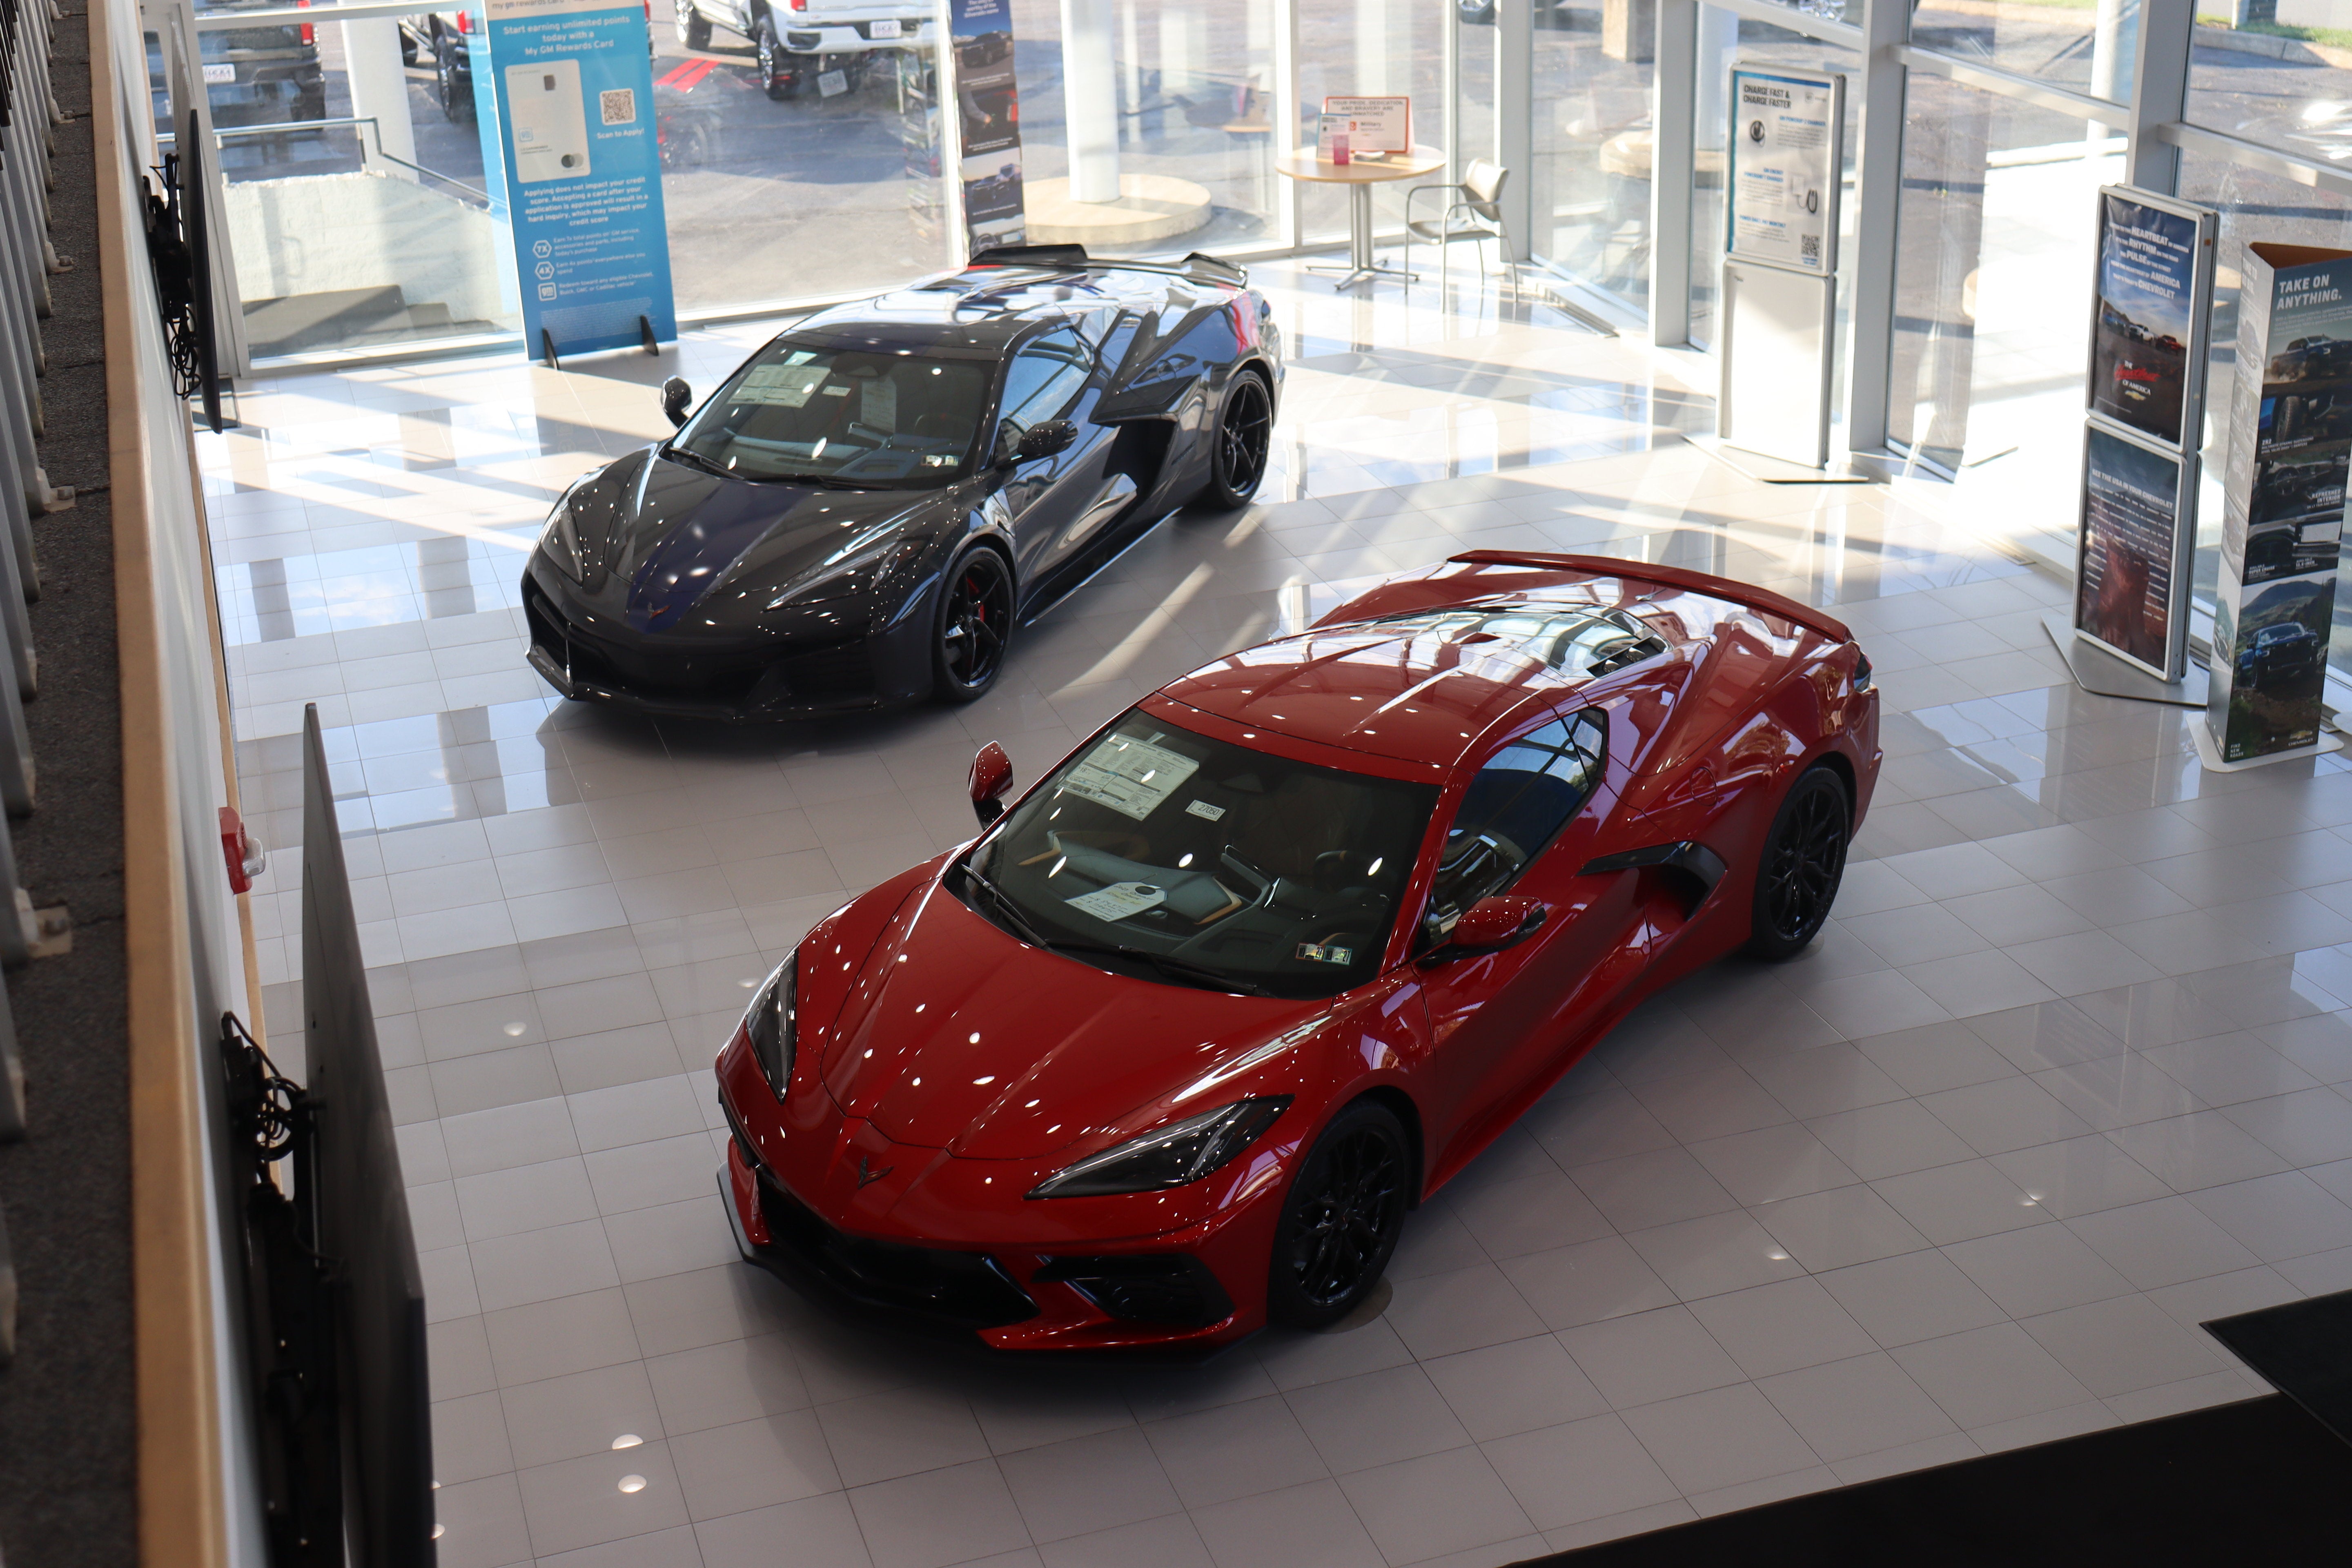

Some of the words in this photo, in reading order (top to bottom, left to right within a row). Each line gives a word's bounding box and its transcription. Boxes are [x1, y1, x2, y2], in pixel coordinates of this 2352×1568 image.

[503, 24, 525, 35] Start
[528, 22, 561, 34] earning
[562, 17, 601, 29] unlimited
[604, 15, 630, 26] points
[542, 33, 566, 43] today
[569, 30, 587, 39] with
[525, 47, 538, 56] My
[540, 45, 554, 53] GM
[556, 41, 592, 52] Rewards
[593, 38, 614, 48] Card
[1744, 84, 1768, 96] CHARGE
[1770, 88, 1783, 98] FAST
[1785, 90, 1789, 98] &
[1744, 94, 1768, 105] CHARGE
[1769, 98, 1791, 109] FASTER
[597, 131, 614, 139] Scan
[623, 127, 644, 137] Apply!
[523, 187, 554, 198] Applying
[586, 181, 608, 190] impact
[551, 192, 586, 203] Accepting
[525, 204, 562, 215] application
[571, 199, 601, 209] approved
[545, 212, 570, 221] inquiry,
[571, 209, 591, 217] which
[608, 204, 630, 213] impact
[2132, 226, 2169, 246] HEARTBEAT
[2129, 238, 2156, 255] RHYTHM
[2126, 249, 2147, 264] PULSE
[2151, 271, 2180, 289] AMERICA
[2278, 276, 2310, 294] TAKE
[2313, 273, 2329, 288] ON
[2138, 279, 2174, 299] CHEVROLET
[2276, 287, 2342, 312] ANYTHING.
[2124, 360, 2132, 370] THE
[2123, 379, 2129, 387] OF
[2129, 381, 2151, 395] AMERICA
[2092, 468, 2100, 478] SEE
[2102, 472, 2111, 482] THE
[2112, 477, 2123, 487] USA
[2123, 481, 2128, 490] IN
[2129, 484, 2142, 496] YOUR
[2142, 490, 2173, 510] CHEVROLET
[2312, 489, 2341, 499] REFRESHED
[2317, 494, 2340, 503] INTERIOR
[1198, 804, 1220, 815] 27050
[1315, 947, 1323, 959] 27
